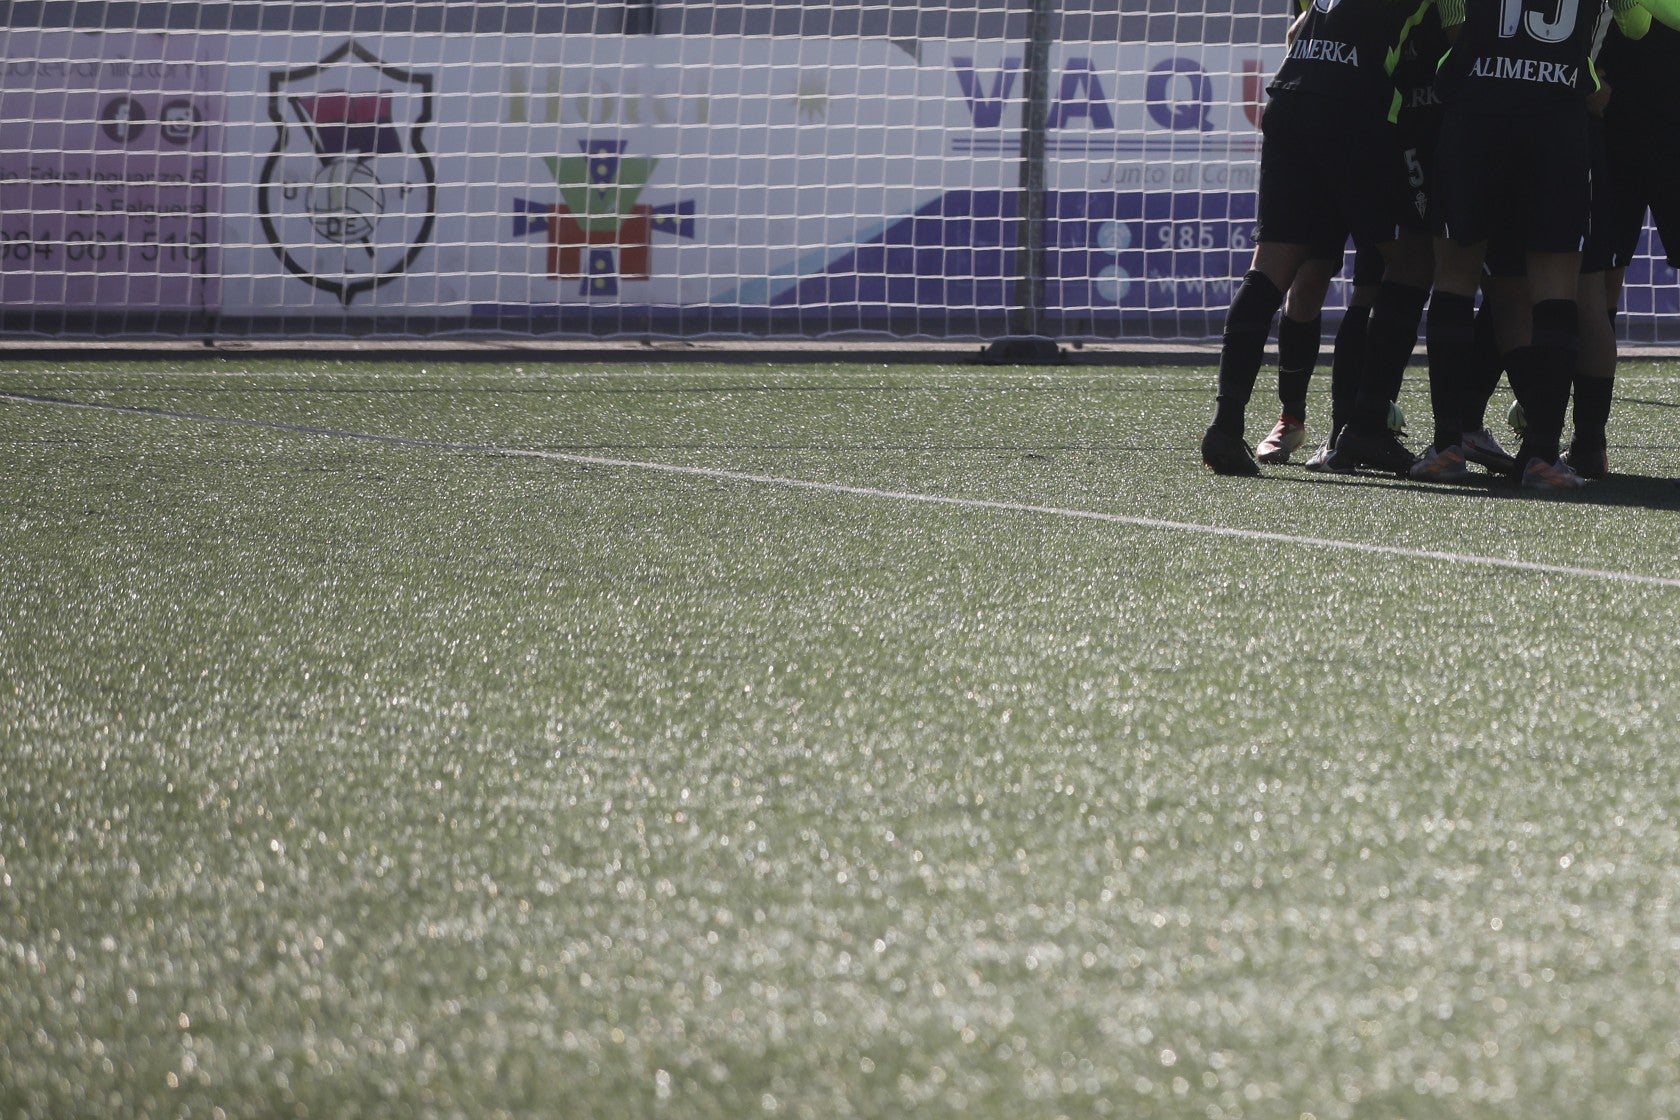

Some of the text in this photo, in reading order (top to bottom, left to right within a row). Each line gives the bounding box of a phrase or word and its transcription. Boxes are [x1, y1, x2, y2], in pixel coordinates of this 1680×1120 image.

[1287, 39, 1359, 67] IMERKA
[1470, 56, 1579, 89] ALIMERKA
[1158, 225, 1214, 250] 985
